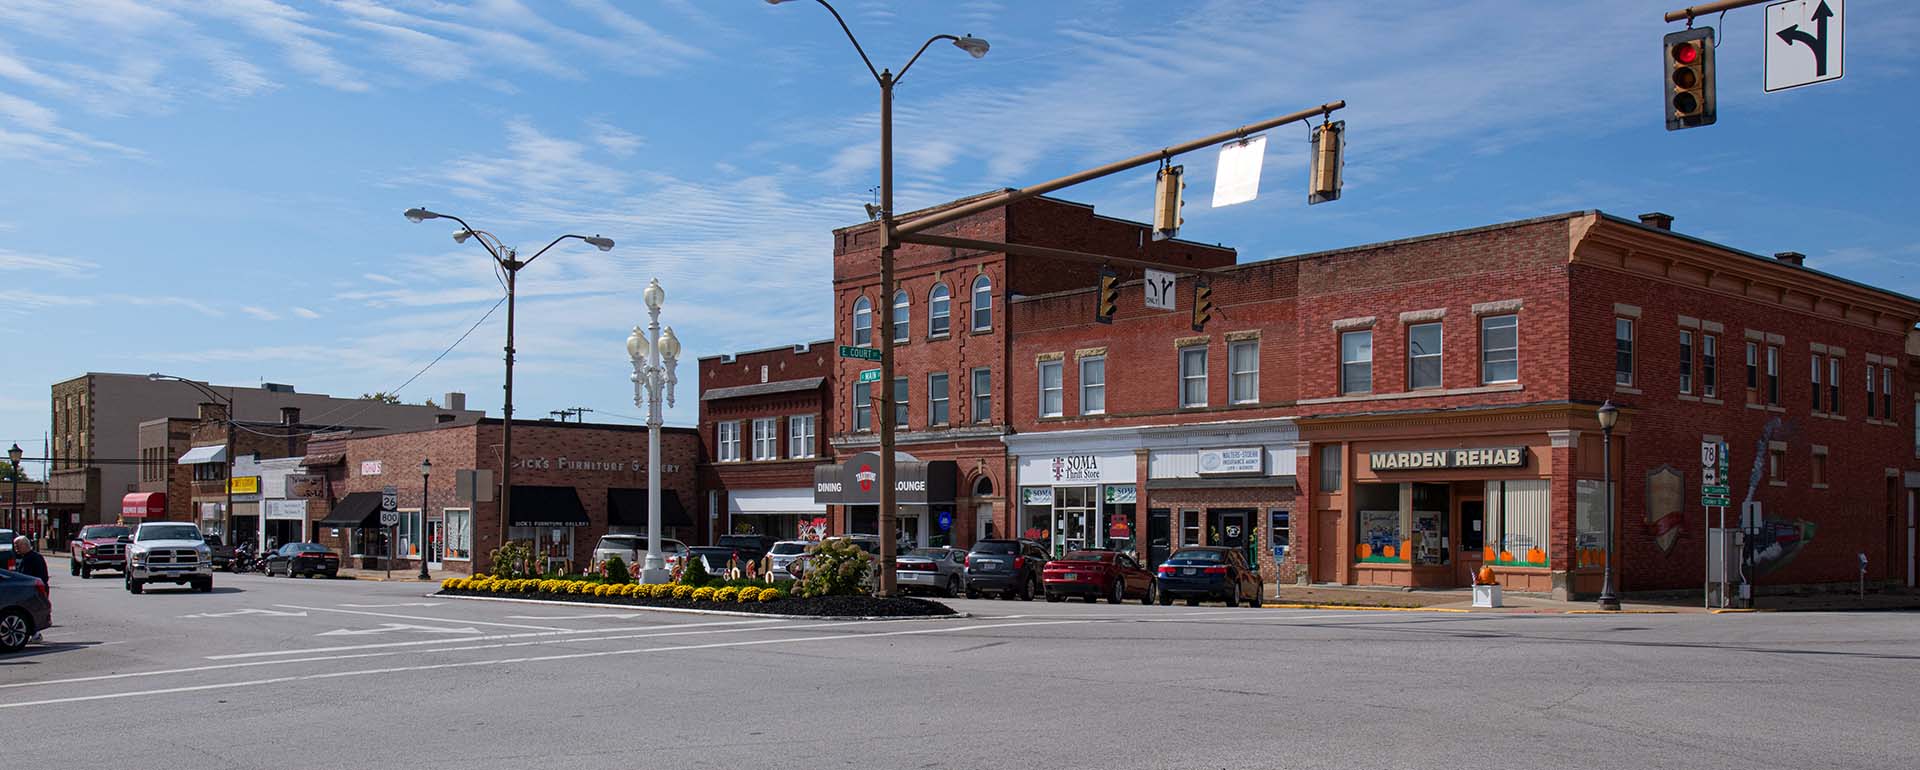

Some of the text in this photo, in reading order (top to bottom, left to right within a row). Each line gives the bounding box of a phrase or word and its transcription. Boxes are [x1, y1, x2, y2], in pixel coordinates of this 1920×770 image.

[1146, 297, 1159, 305] ONLY
[850, 349, 872, 358] COURT
[865, 371, 877, 380] MAIN
[1371, 449, 1521, 469] MARDEN REHAB
[1704, 447, 1715, 461] 78
[631, 460, 680, 473] GERY
[1067, 455, 1097, 470] SOMA
[1066, 469, 1100, 479] Thrift Store
[817, 481, 926, 492] DINING LOUNGE
[383, 498, 396, 506] 26
